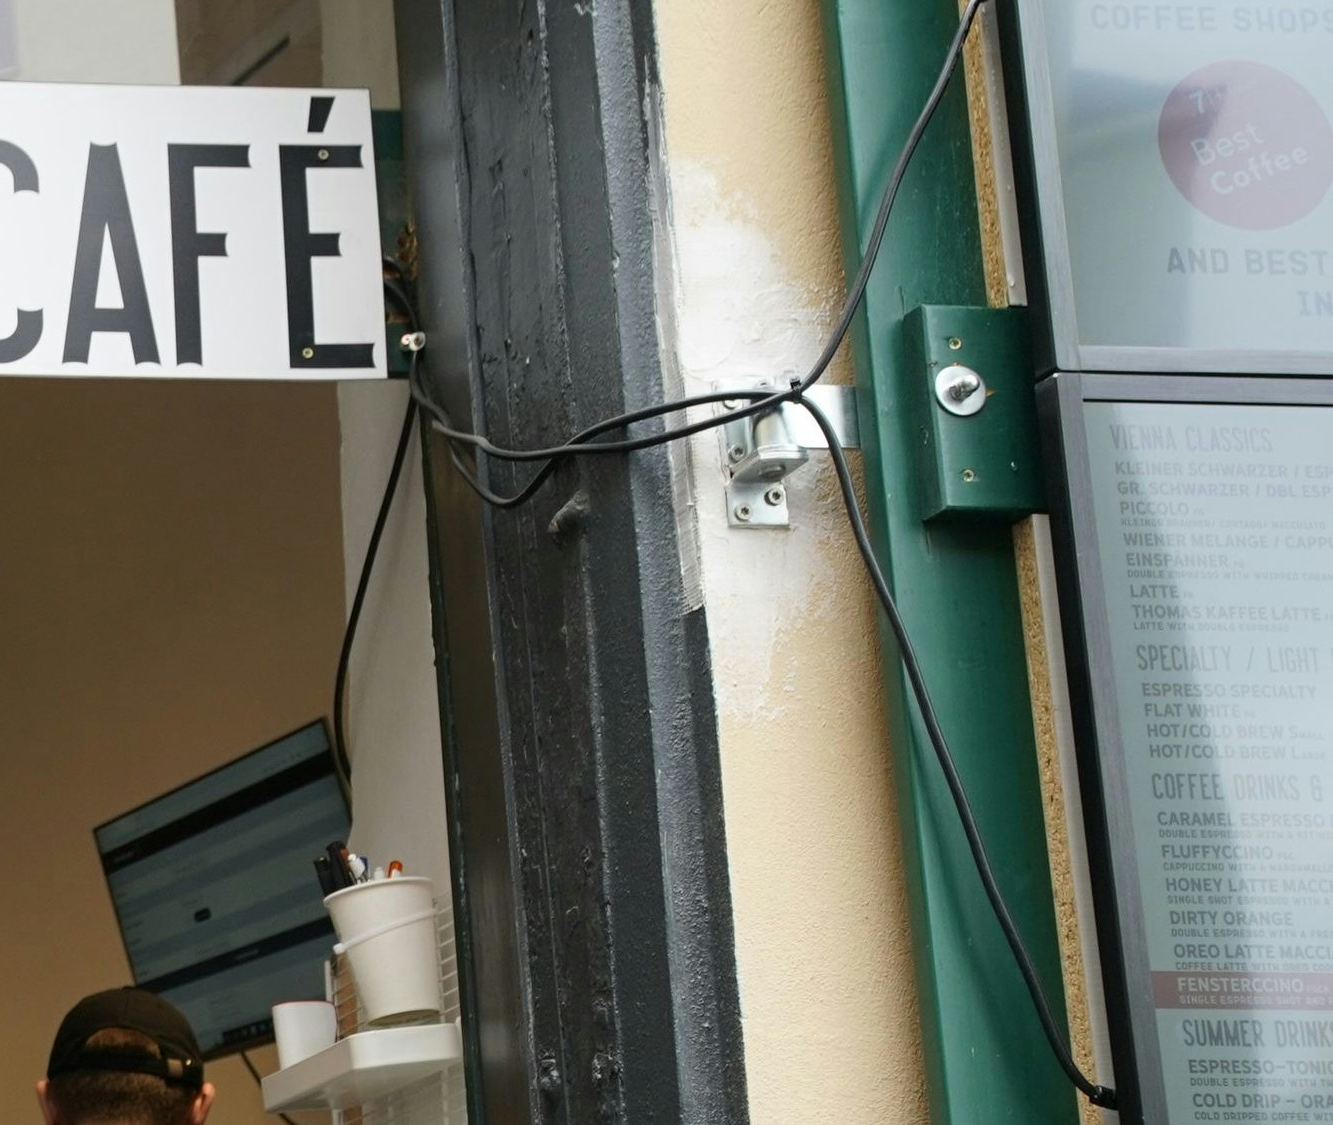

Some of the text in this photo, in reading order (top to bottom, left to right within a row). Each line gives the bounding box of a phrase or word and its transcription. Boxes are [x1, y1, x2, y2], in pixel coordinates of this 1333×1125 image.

[1090, 5, 1217, 31] COFFEE
[1190, 121, 1265, 166] Best
[1209, 146, 1310, 196] Coffee
[1166, 247, 1329, 276] AND BEST
[1110, 425, 1273, 452] VIENNA CLASSICS
[1115, 461, 1288, 478] KLEINER SCHWARZER
[1148, 482, 1249, 497] SCHWARZER
[1120, 501, 1190, 516] PICCOLO
[1123, 532, 1269, 549] WIENER MELANGE
[1130, 584, 1179, 599] LATTE
[1131, 604, 1202, 619] THOMAS
[1206, 605, 1267, 620] KAFFEE
[1271, 606, 1322, 622] LATTE
[1136, 644, 1320, 673] SPECIALTY LIGHT
[1142, 683, 1317, 700] ESPRESSO SPECIALTY
[1144, 703, 1183, 718] FLAT
[1187, 704, 1241, 718] WHITE
[1147, 723, 1284, 739] HOT/COLD BREW
[1149, 744, 1286, 760] HOT/COLD BREW
[1151, 773, 1224, 800] COFFEE
[1234, 773, 1301, 801] DRINKS
[1157, 811, 1325, 828] CARAMEL ESPRESSO
[1161, 844, 1273, 860] FLUFFYCCINO
[1165, 878, 1278, 893] HONEY LATTE
[1169, 910, 1294, 926] DIRTY ORANGE
[1173, 944, 1275, 959] OREO LATTE
[1177, 977, 1304, 993] FENSTERCCINO
[1182, 1019, 1266, 1047] SUMMER
[1192, 1092, 1281, 1108] COLD DRIP
[1194, 1111, 1220, 1120] COLD
[1271, 1112, 1310, 1121] COFFEE
